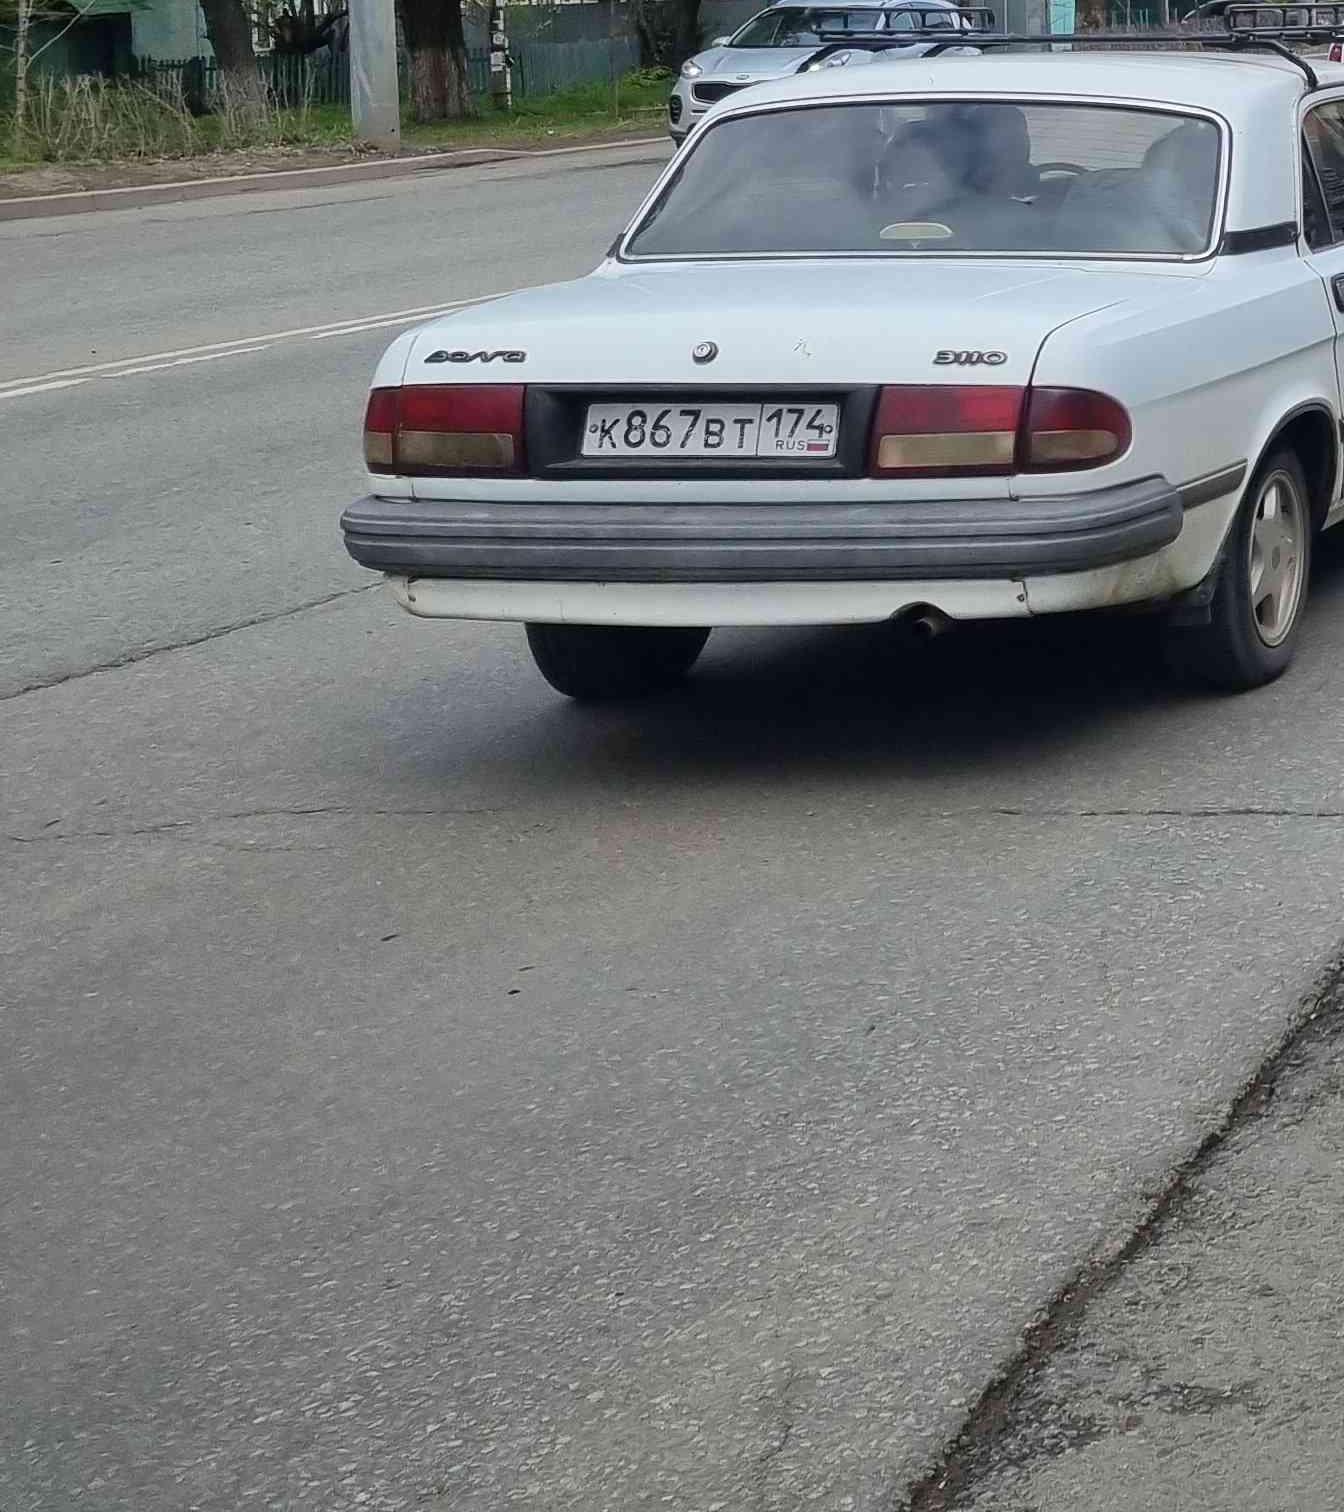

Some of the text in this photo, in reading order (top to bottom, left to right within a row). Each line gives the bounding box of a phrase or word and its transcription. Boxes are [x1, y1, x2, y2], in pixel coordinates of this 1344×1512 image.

[598, 407, 826, 450] К867ВТ 174
[775, 438, 806, 451] RUS
